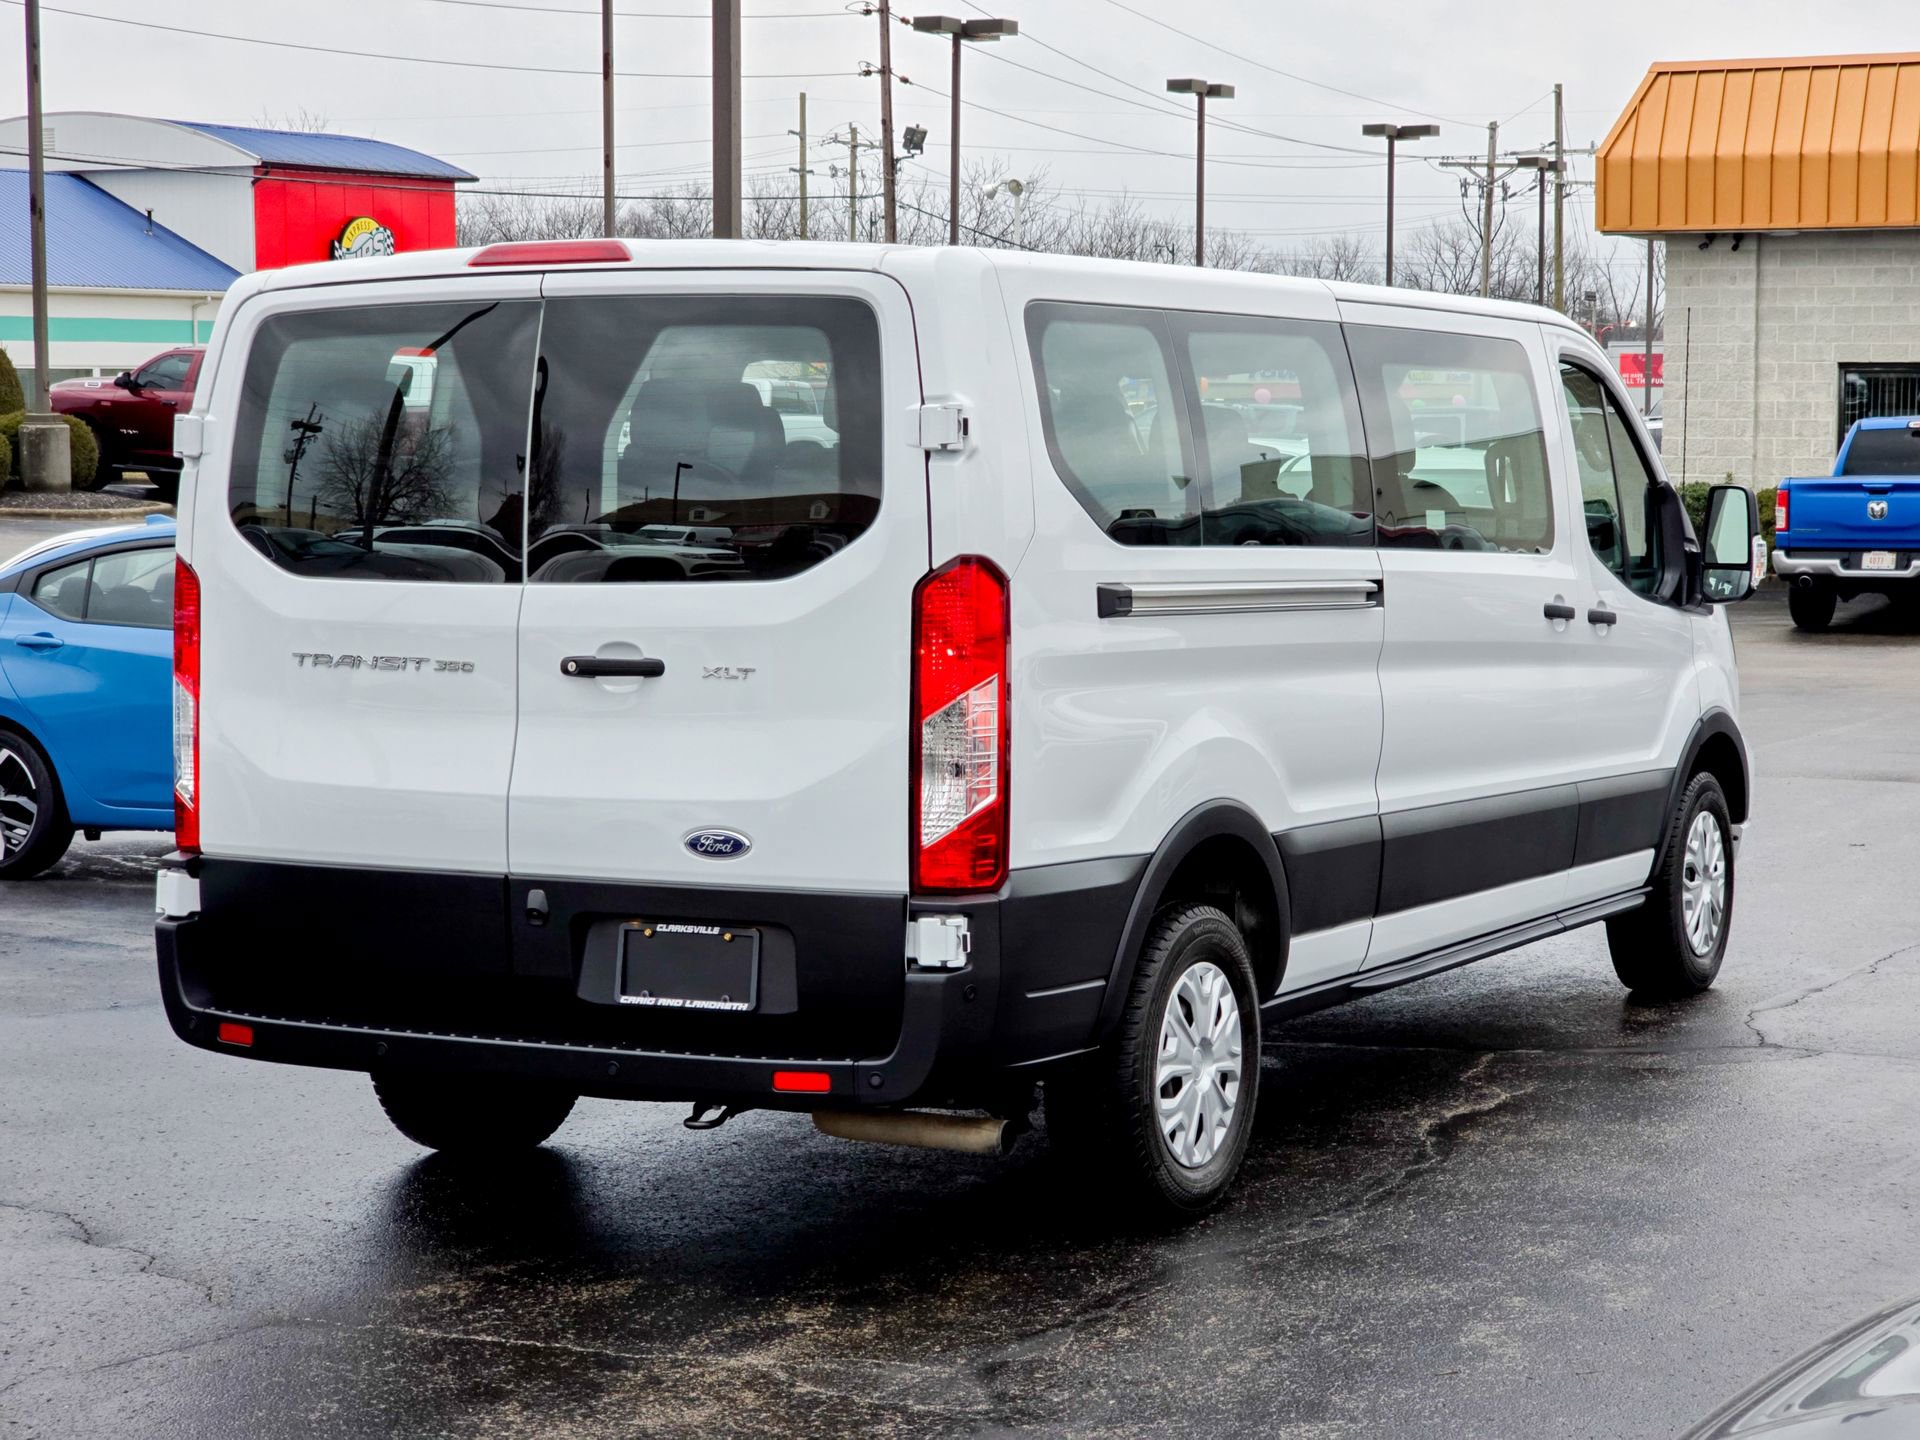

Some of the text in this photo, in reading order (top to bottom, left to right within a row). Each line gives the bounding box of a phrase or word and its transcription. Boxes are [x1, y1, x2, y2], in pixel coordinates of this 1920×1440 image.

[346, 220, 371, 242] EXPRESS
[292, 652, 475, 673] TRANSIT 350
[702, 666, 756, 680] XLT
[697, 834, 735, 853] Ford
[656, 923, 720, 935] CLARKSVILLE
[620, 995, 749, 1011] CRAIG AND LANDRETH
